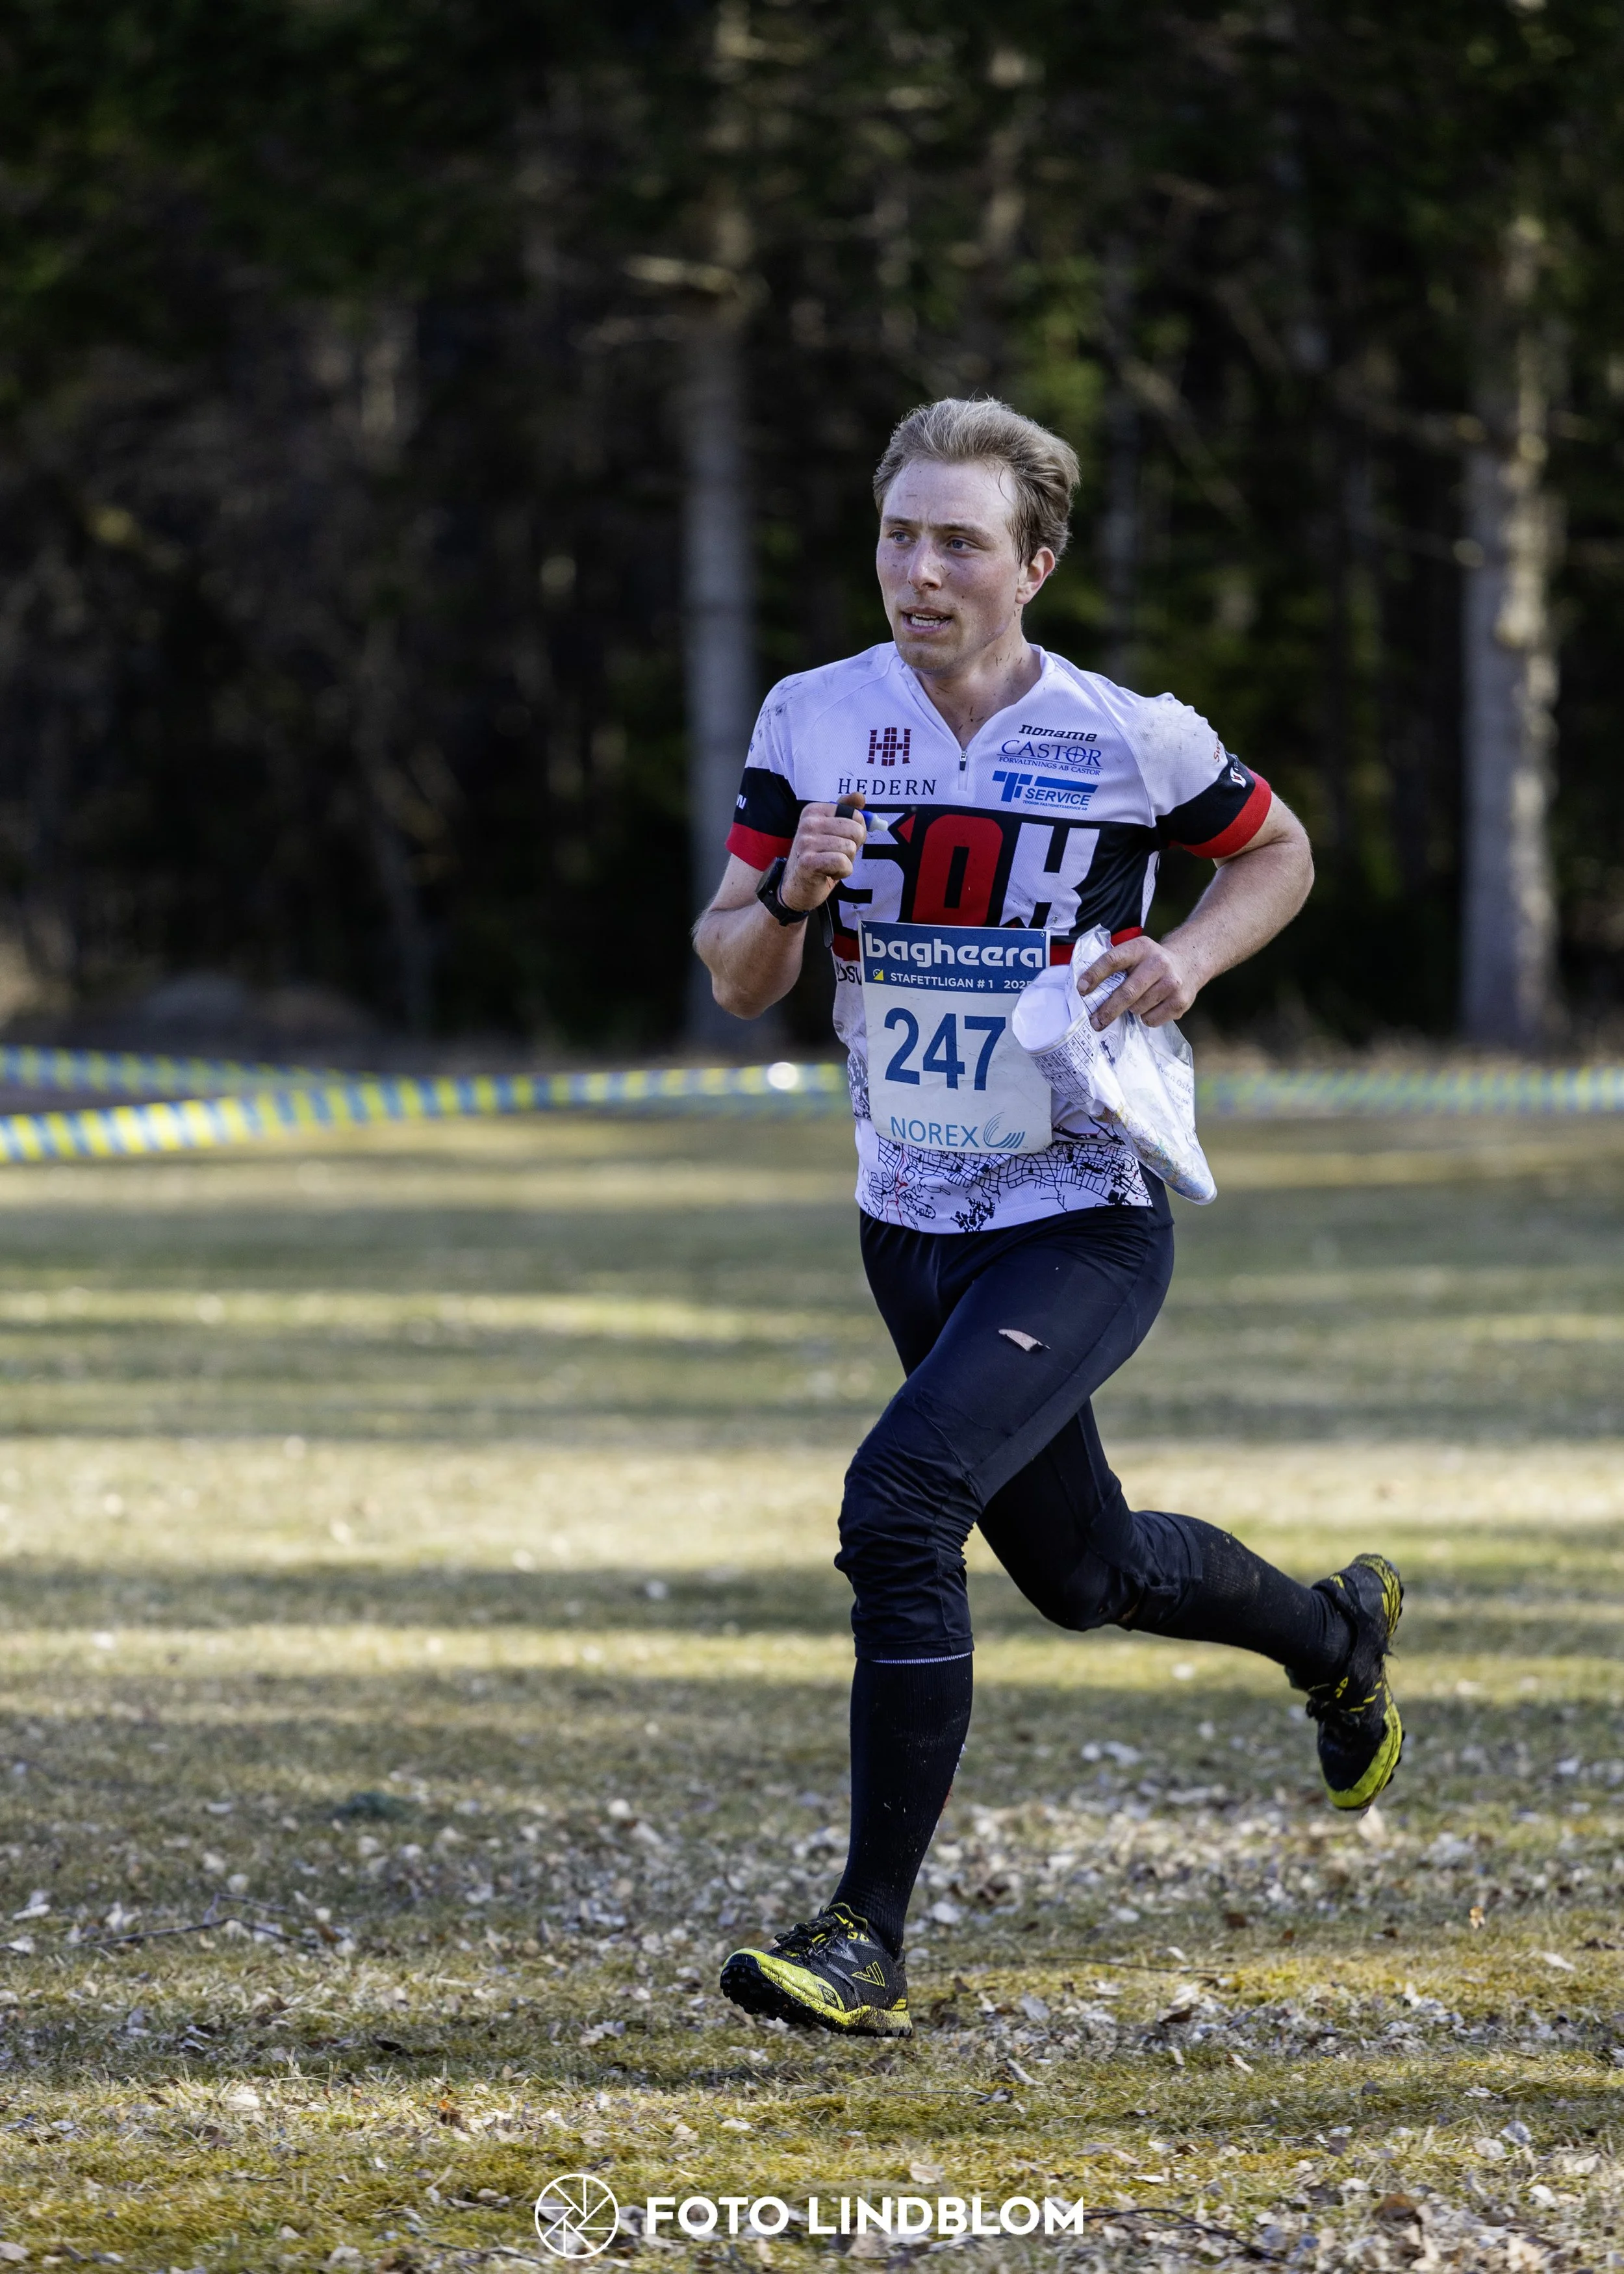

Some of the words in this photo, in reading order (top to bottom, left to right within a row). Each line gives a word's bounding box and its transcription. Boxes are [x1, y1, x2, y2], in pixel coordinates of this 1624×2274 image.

[1019, 724, 1097, 742] noname
[1001, 740, 1102, 767] CASTOR
[1071, 767, 1100, 776] CASTOR
[837, 778, 937, 795] HEDERN
[1025, 788, 1091, 806] SERVICE
[865, 932, 1043, 968] bagheera
[890, 972, 974, 988] STAFETTLIGAN
[977, 979, 985, 989] #
[988, 979, 993, 989] 1
[884, 1007, 1006, 1091] 247
[891, 1116, 980, 1148] NOREX
